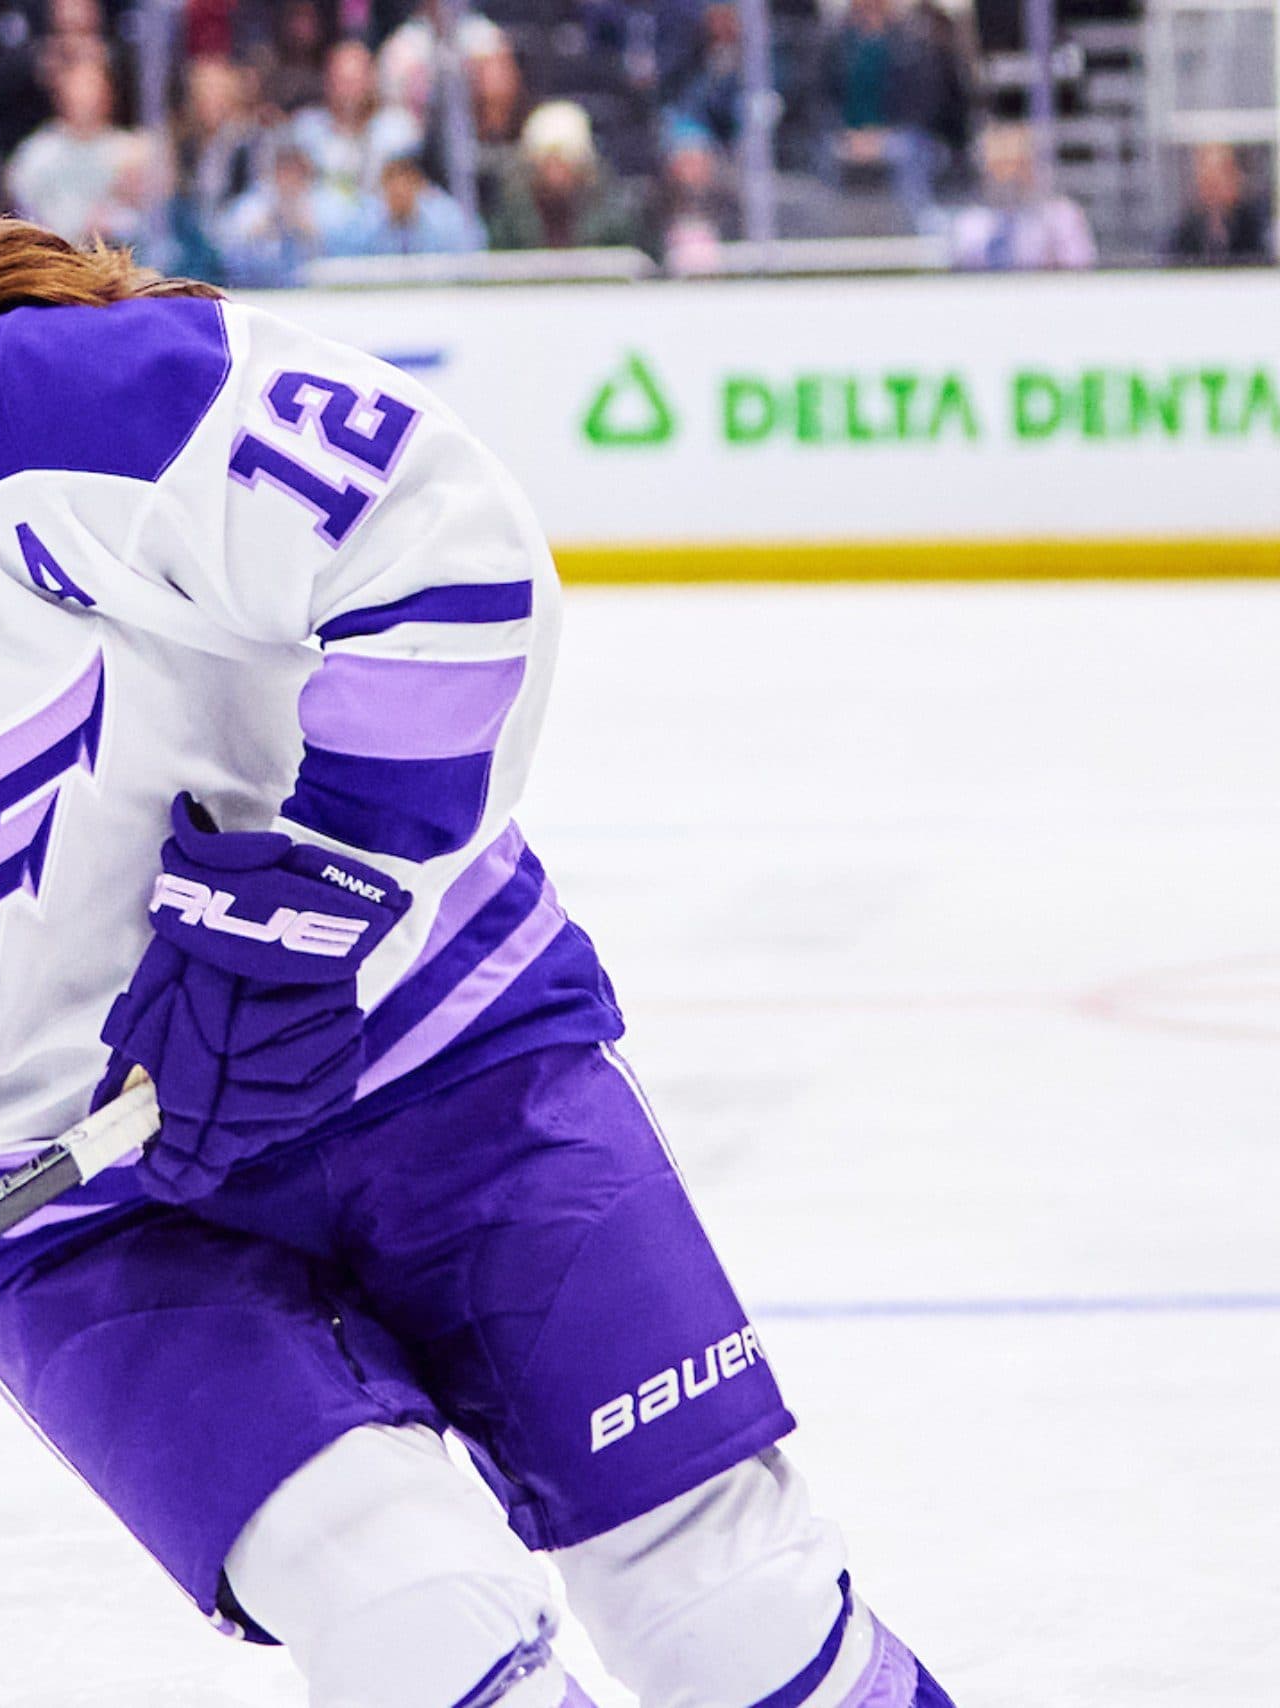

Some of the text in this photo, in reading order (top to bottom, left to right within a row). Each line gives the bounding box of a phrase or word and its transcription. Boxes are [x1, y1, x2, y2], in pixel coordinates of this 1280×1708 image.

[721, 366, 982, 443] DELTA
[228, 368, 424, 551] 12
[15, 521, 97, 607] A
